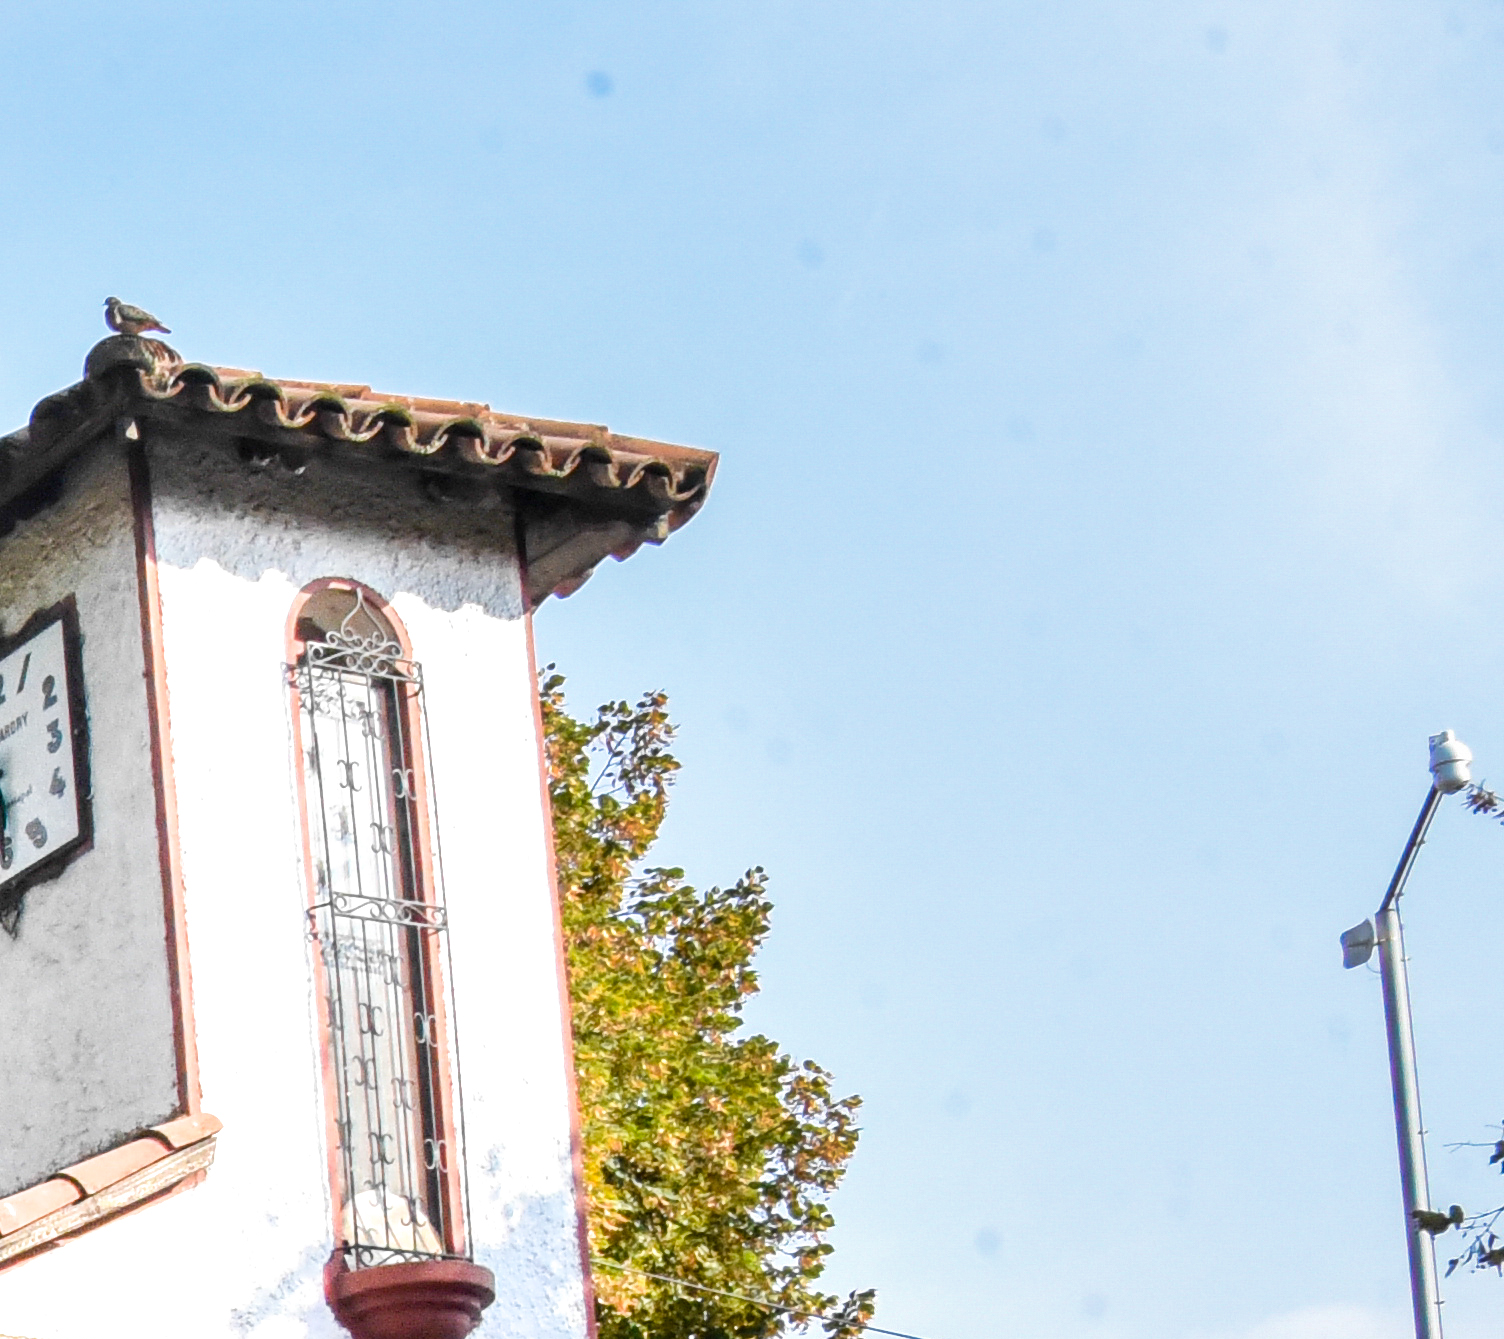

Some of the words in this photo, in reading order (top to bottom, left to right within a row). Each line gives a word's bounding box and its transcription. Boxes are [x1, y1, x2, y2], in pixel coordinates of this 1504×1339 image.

[41, 674, 58, 711] 2
[46, 718, 63, 754] 3
[49, 767, 67, 798] 4
[25, 817, 48, 849] 5
[0, 836, 14, 870] 6
